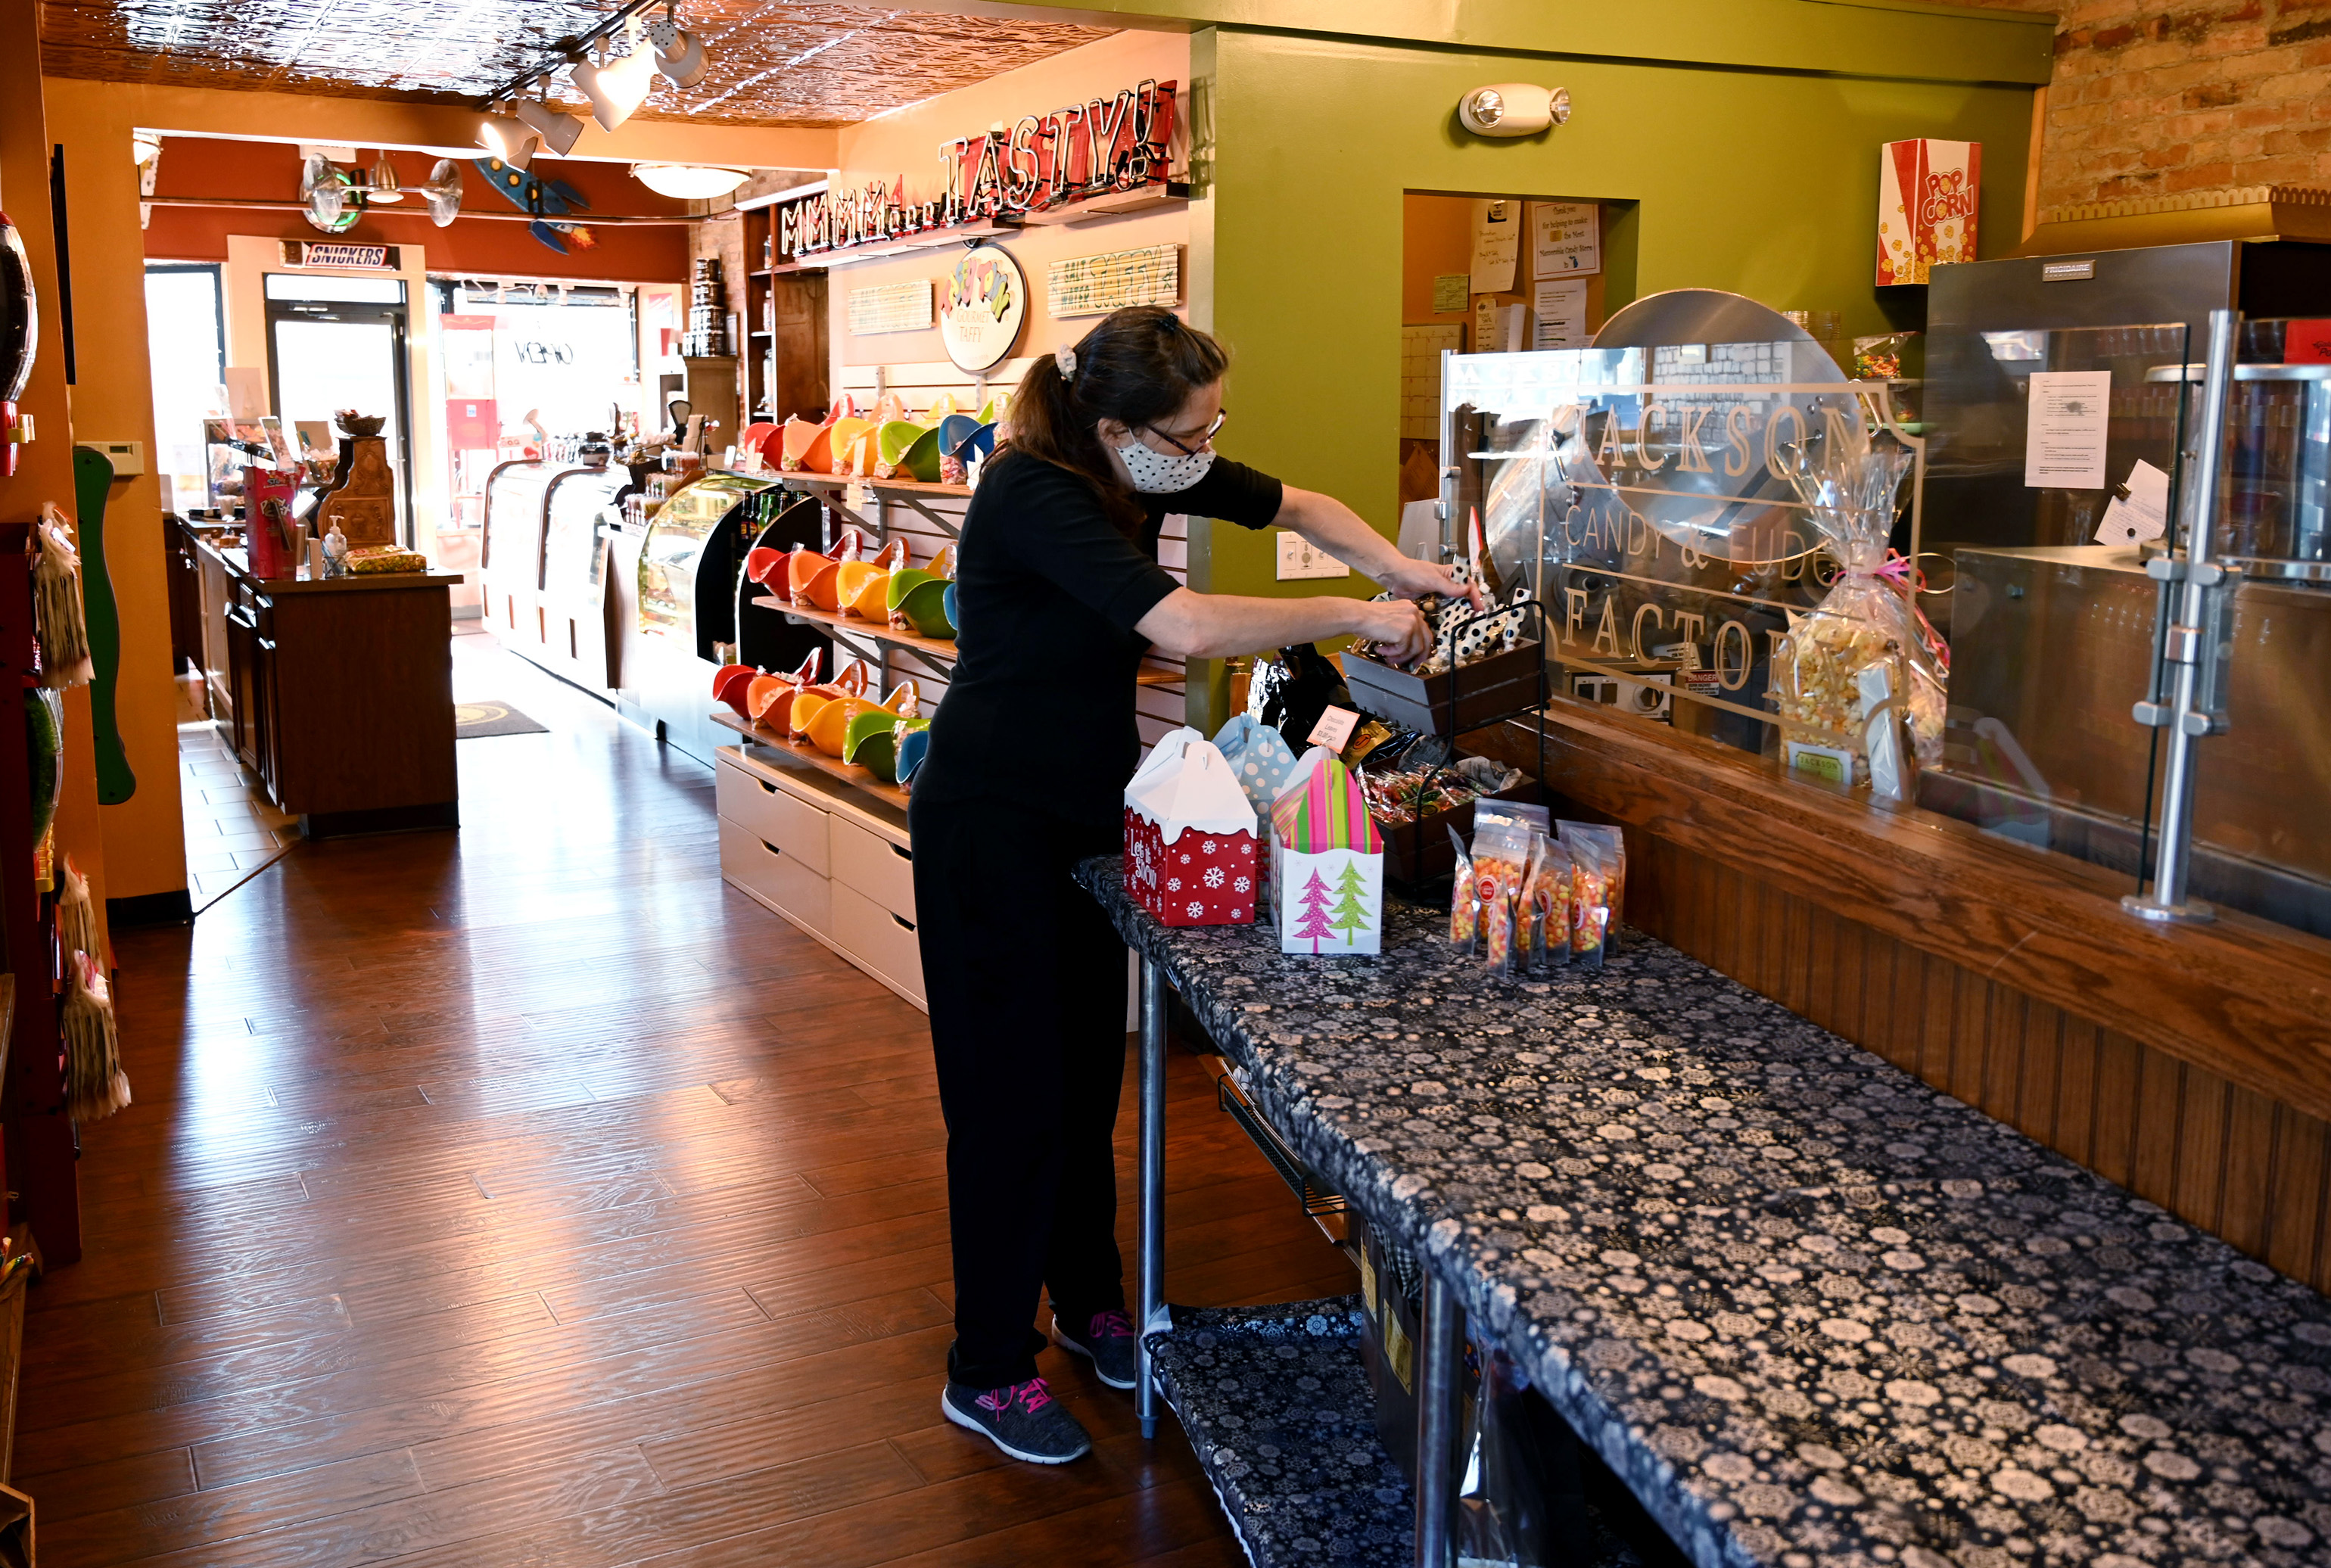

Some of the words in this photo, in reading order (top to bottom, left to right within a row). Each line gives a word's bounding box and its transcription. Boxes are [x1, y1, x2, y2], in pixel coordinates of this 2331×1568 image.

[938, 78, 1158, 221] TASTY!
[1925, 168, 1964, 198] POP
[1922, 184, 1974, 227] CORN
[312, 246, 383, 265] SNICKERS
[2045, 264, 2090, 274] FRIGIDAIRE
[1089, 245, 1162, 308] TAFFY
[959, 326, 984, 343] TAFFY
[1572, 403, 1872, 484] JACKSON
[1566, 505, 1664, 558] CANDY
[1681, 525, 1709, 570] &
[1729, 524, 1869, 590] FUDGE
[1561, 587, 1856, 715] FACTORY
[1688, 674, 1717, 682] DANGER
[1800, 757, 1839, 770] JACKSON
[1131, 829, 1144, 858] Let
[1145, 843, 1151, 864] it
[1135, 857, 1157, 890] Snow
